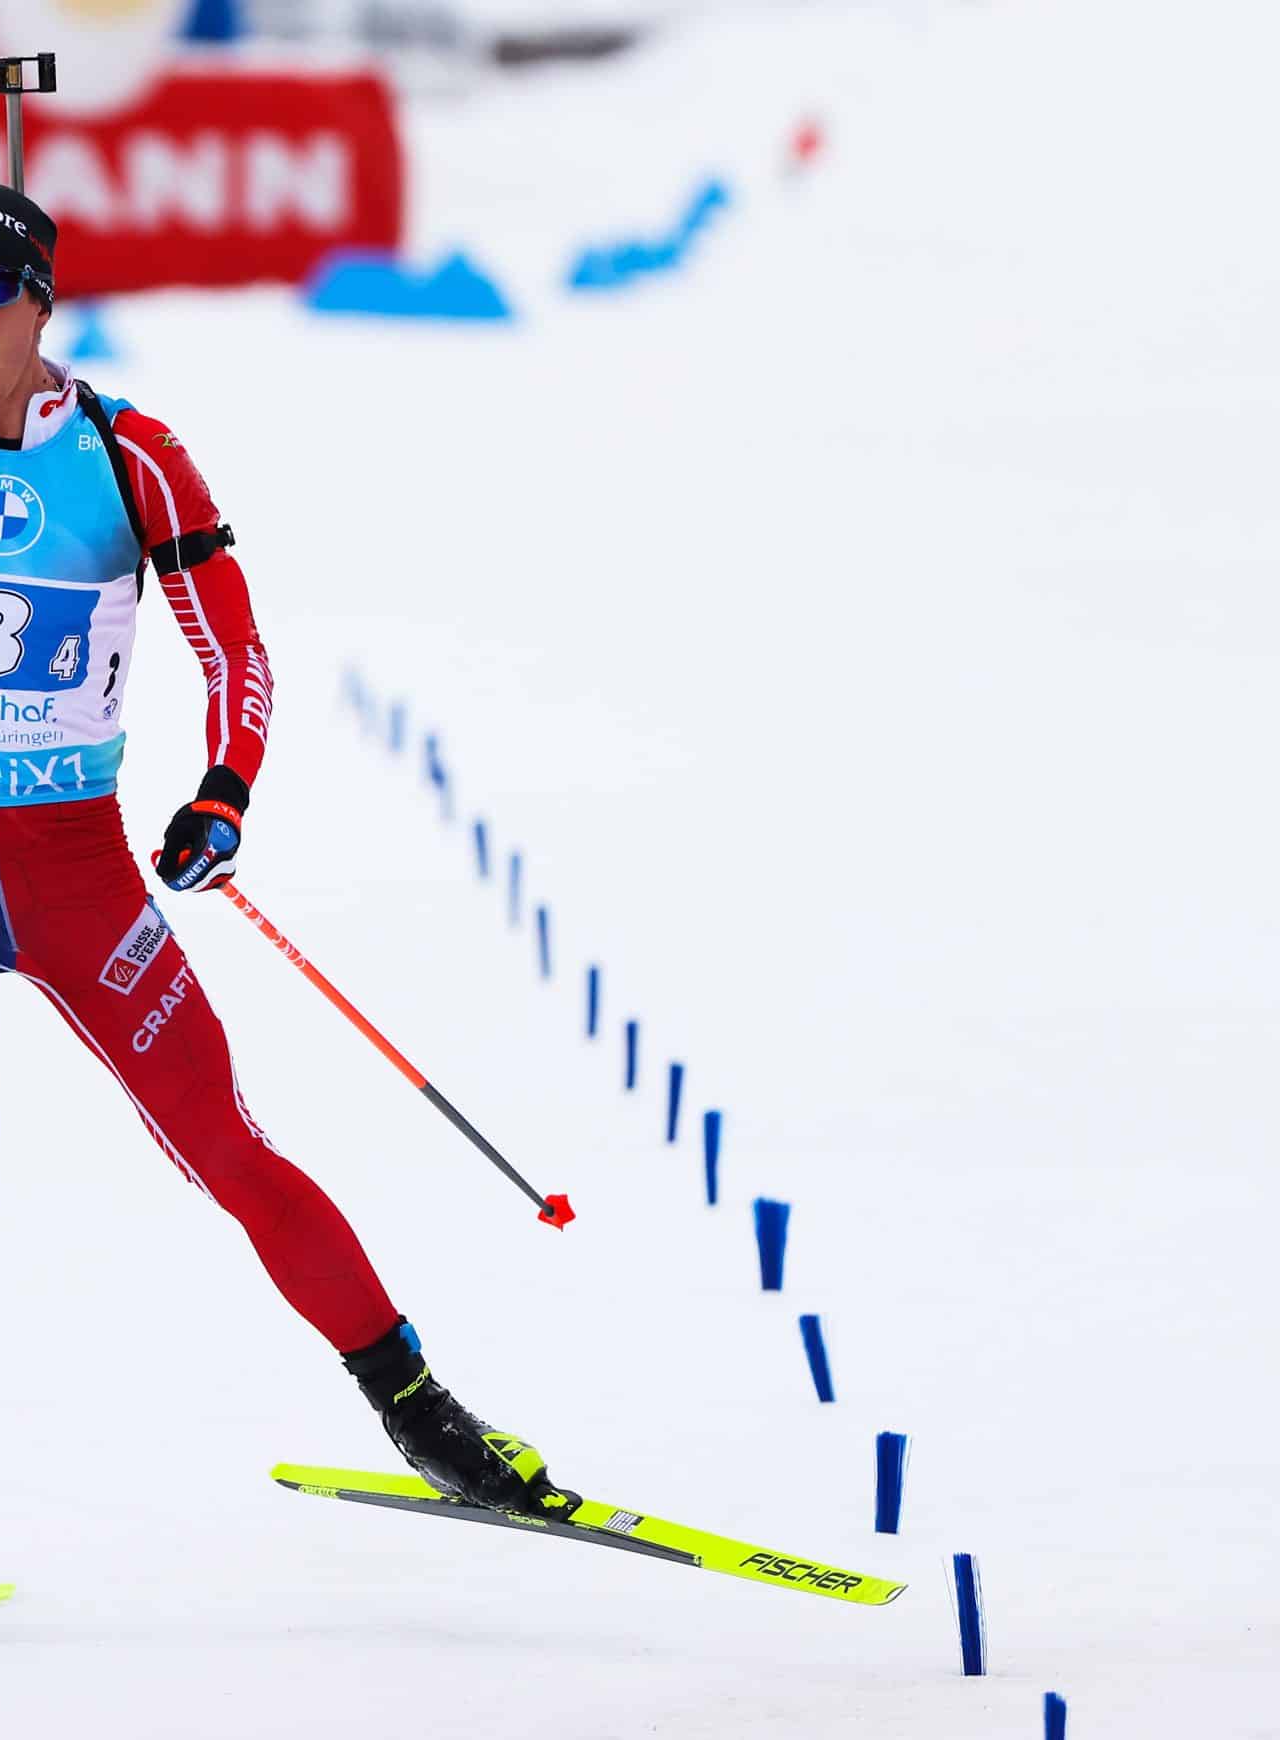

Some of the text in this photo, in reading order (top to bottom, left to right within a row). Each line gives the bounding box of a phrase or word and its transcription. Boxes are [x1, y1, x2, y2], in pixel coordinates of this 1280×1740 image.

[78, 434, 104, 451] BM
[49, 635, 80, 680] 4
[127, 924, 154, 958] CAISSE
[132, 965, 194, 1053] CRAFT
[739, 1552, 863, 1594] FISCHER
